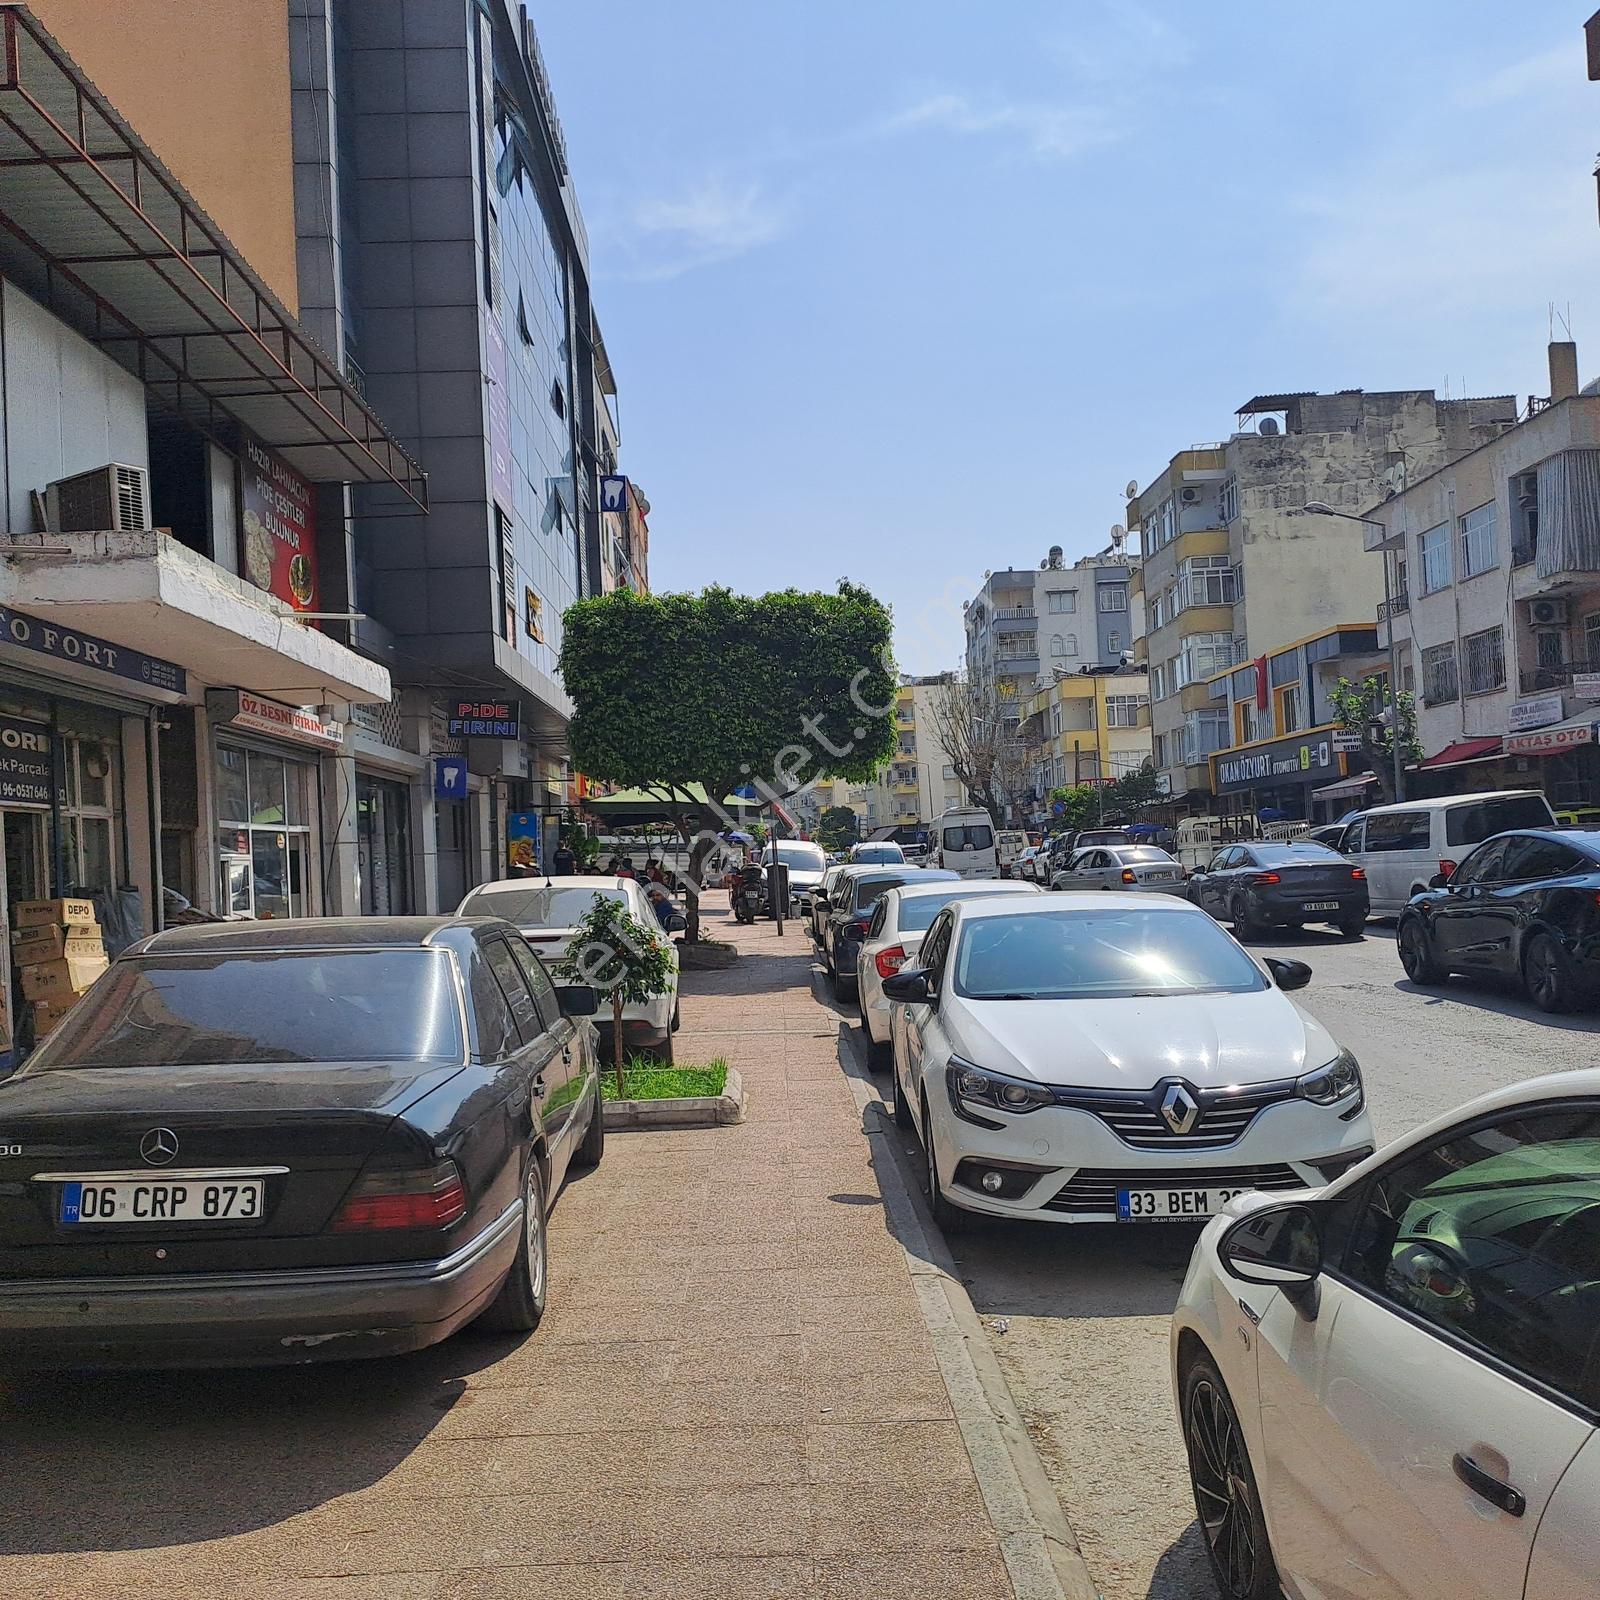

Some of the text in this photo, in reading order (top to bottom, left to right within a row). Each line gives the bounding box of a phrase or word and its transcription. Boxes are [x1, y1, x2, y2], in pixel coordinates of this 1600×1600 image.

[265, 511, 300, 551] BULUNUR
[42, 628, 118, 669] FORT
[241, 693, 258, 715] ÖZ
[450, 719, 517, 736] FIRINI
[1507, 728, 1588, 750] AKTAŞ OTO
[1220, 761, 1240, 784] OKAN
[1240, 754, 1271, 781] ÖZYURT
[68, 905, 90, 915] DEPO
[66, 1186, 257, 1218] TR 06 CRP 873
[1130, 1192, 1156, 1215] 33
[1168, 1191, 1209, 1214] BEM
